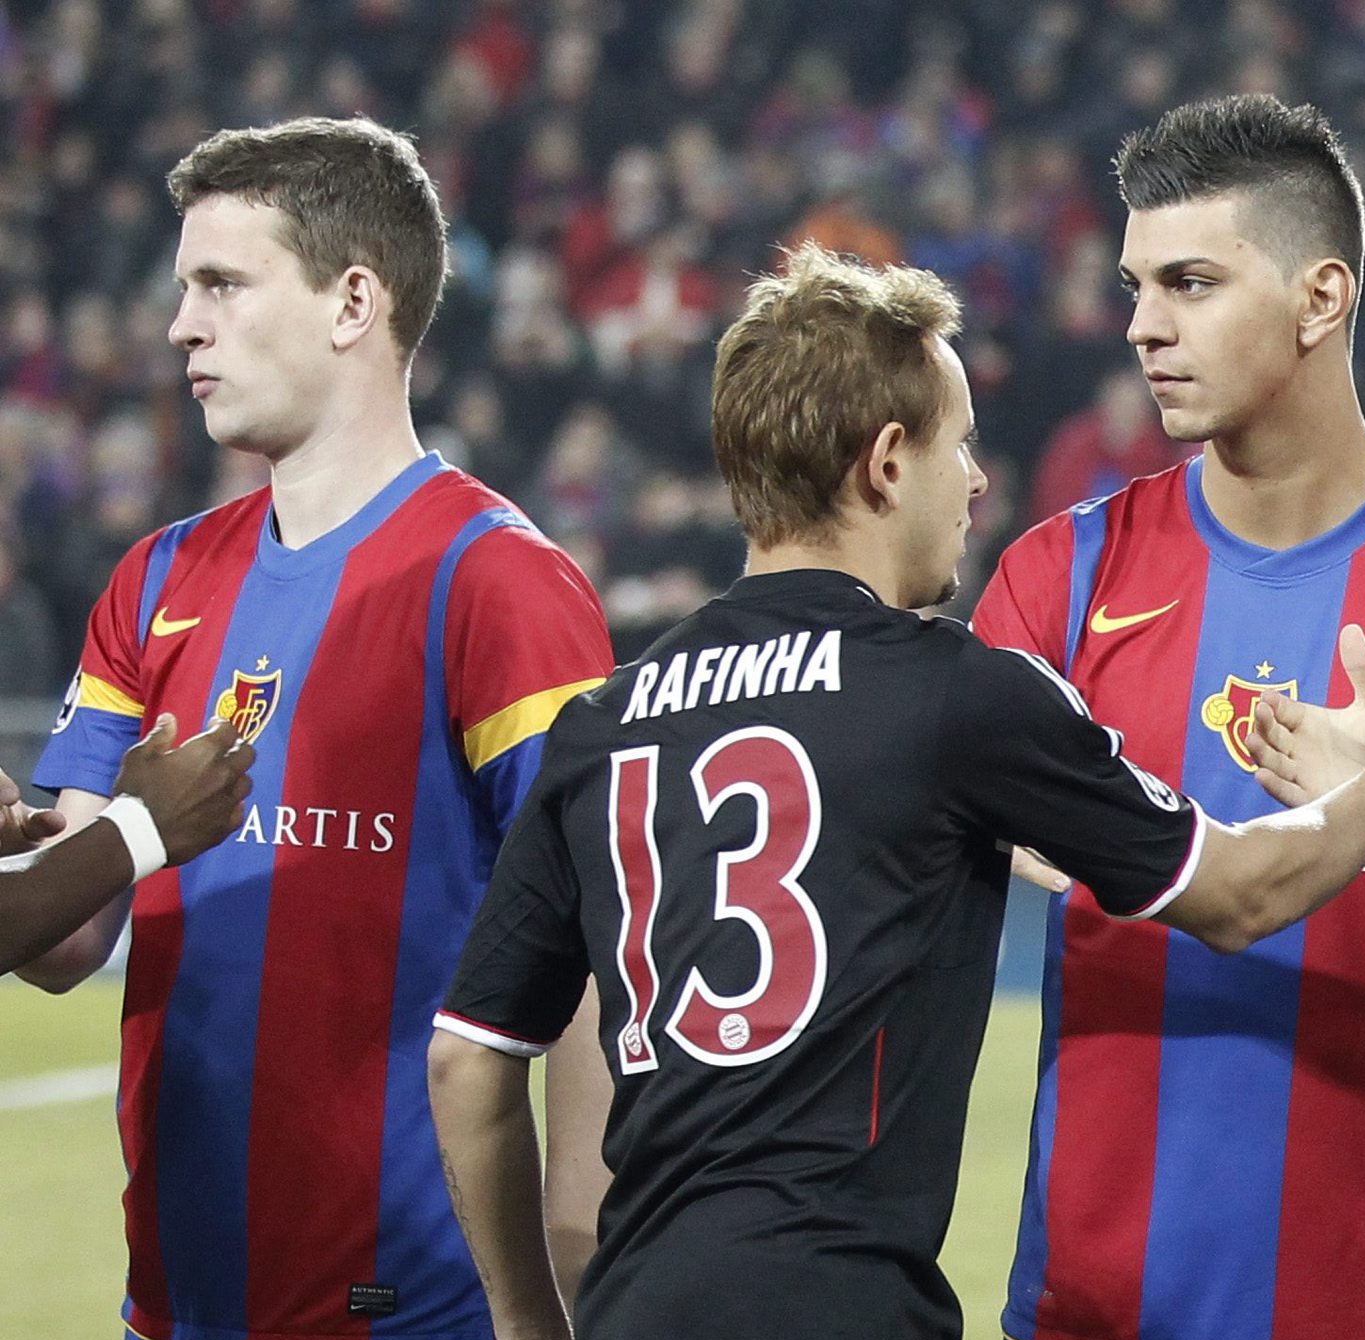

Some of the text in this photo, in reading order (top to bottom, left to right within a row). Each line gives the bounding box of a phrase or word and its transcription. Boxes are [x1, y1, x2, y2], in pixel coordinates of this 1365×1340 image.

[620, 629, 843, 725] RAFINHA
[235, 803, 396, 853] ARTIS
[608, 725, 829, 1076] 13
